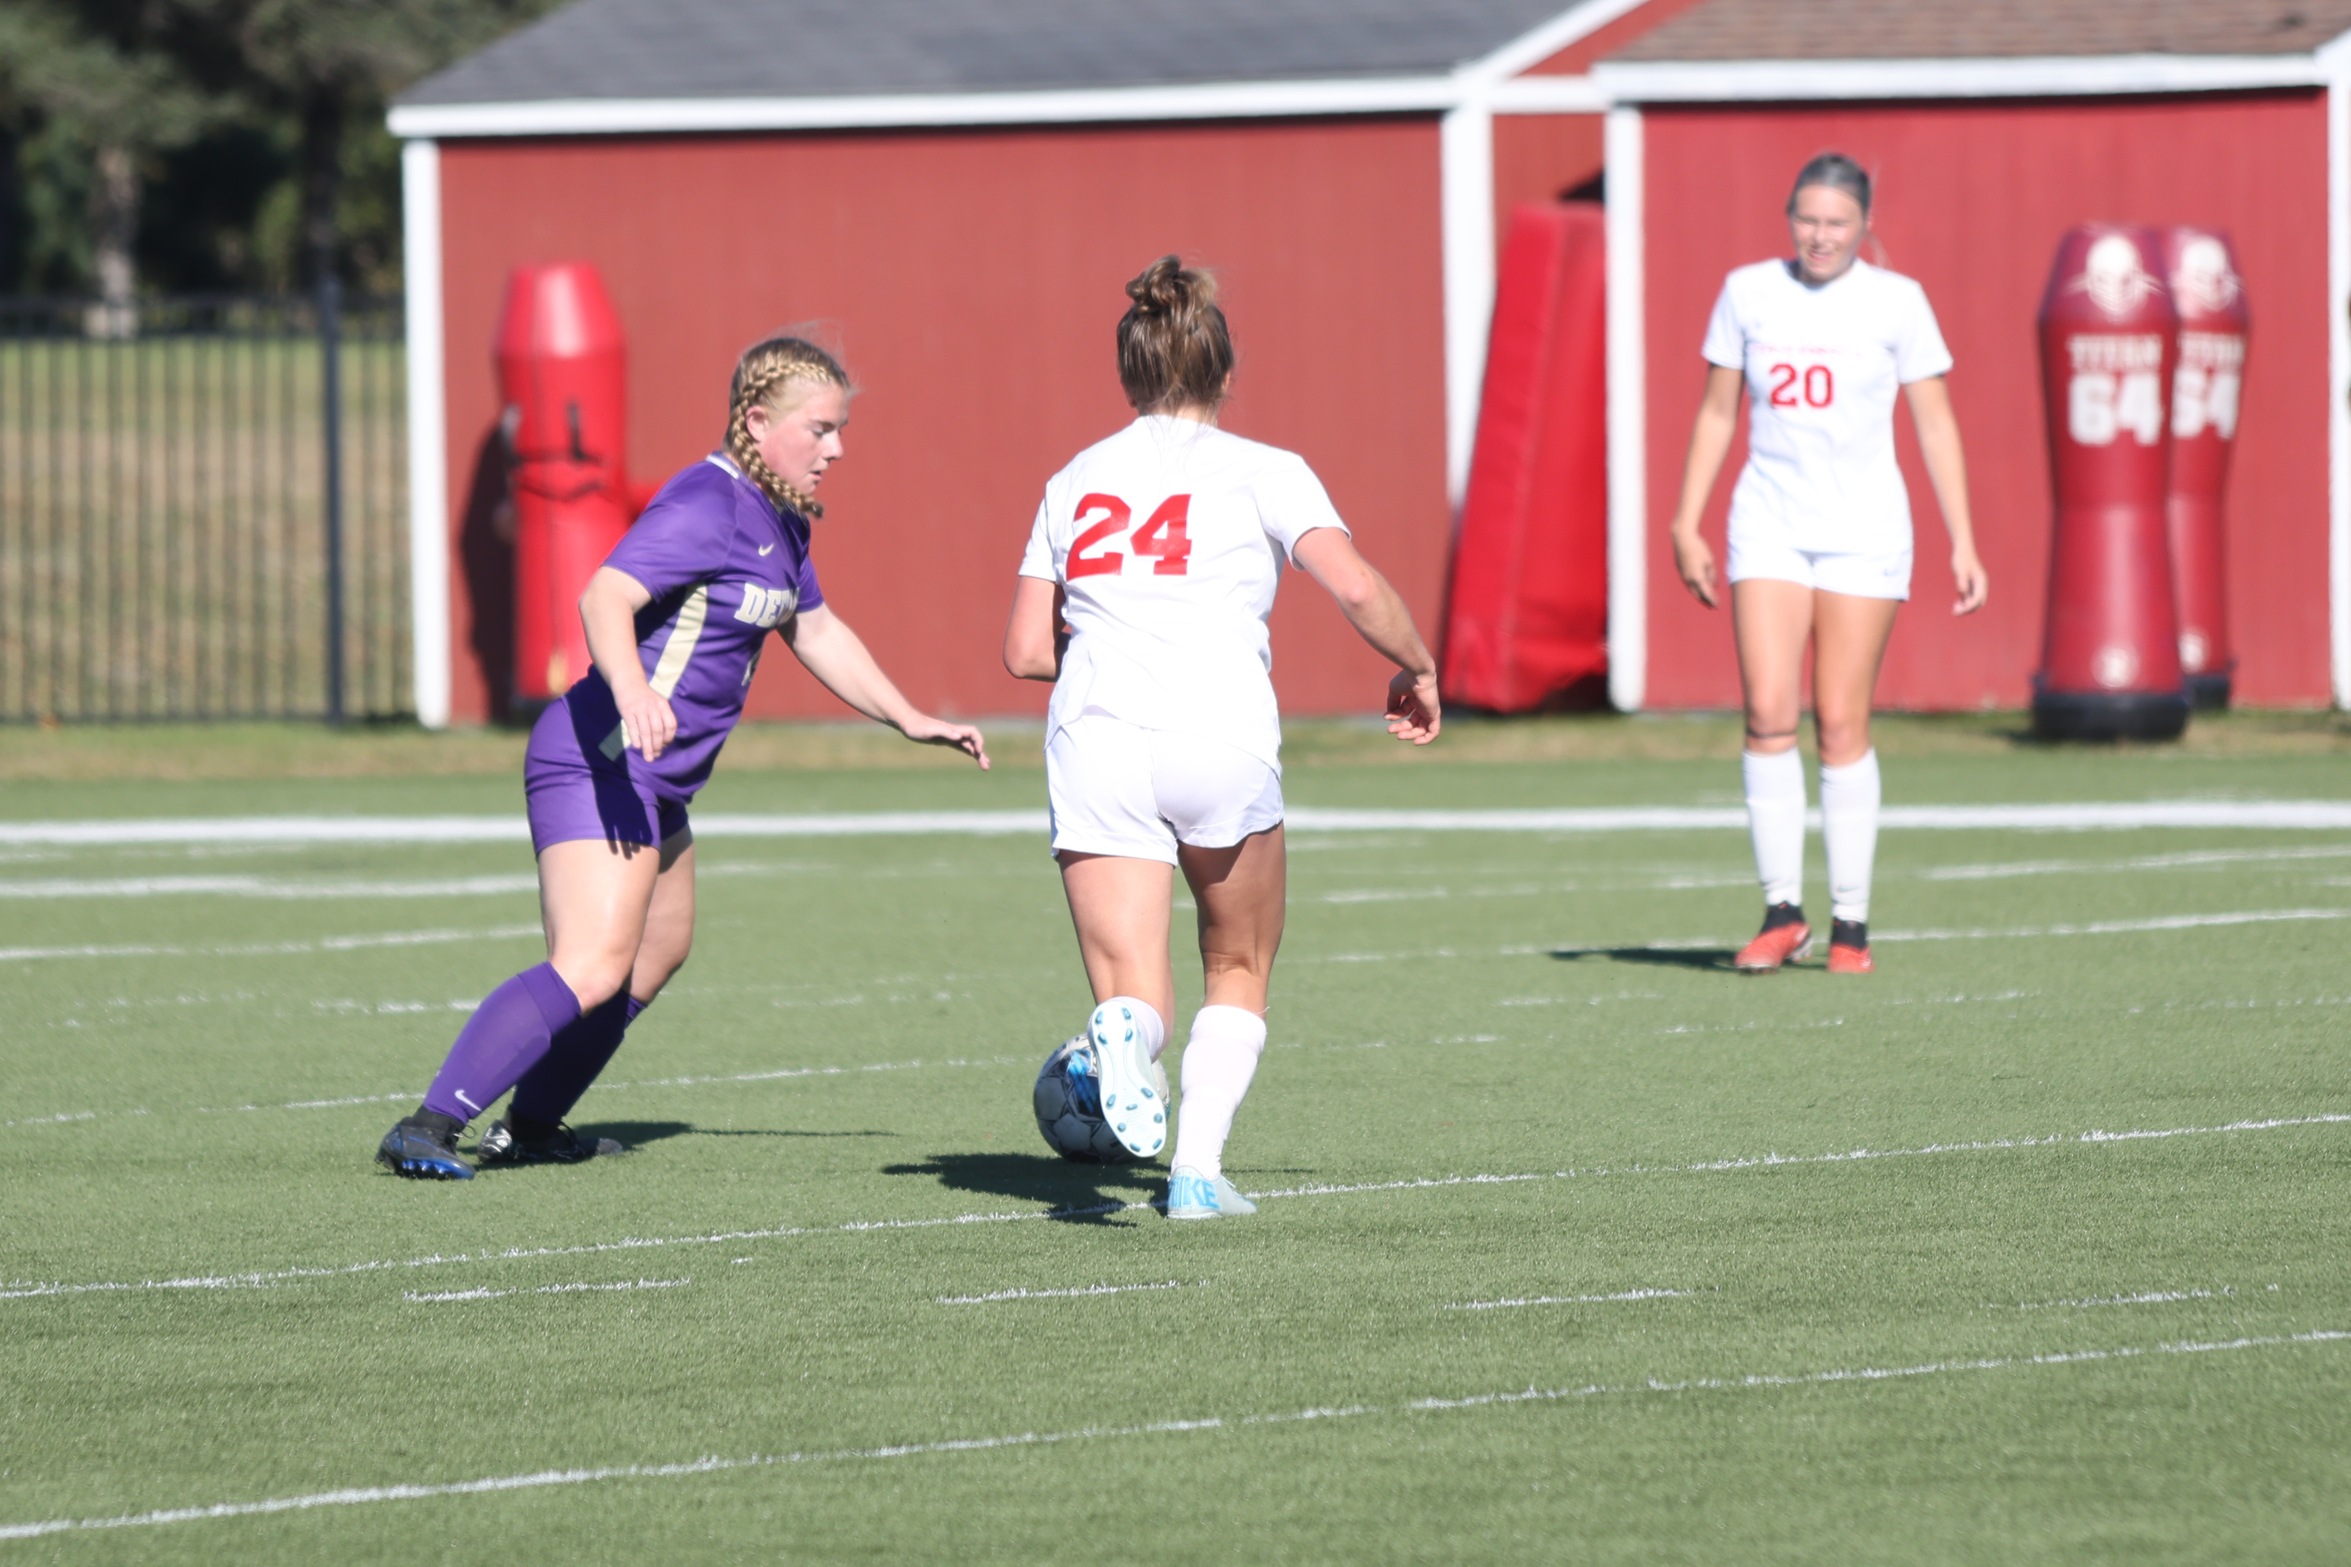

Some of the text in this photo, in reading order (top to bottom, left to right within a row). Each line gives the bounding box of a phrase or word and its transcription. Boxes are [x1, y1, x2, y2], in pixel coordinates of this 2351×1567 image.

[1769, 363, 1834, 409] 20
[2069, 373, 2163, 445] 64
[1066, 492, 1192, 582] 24
